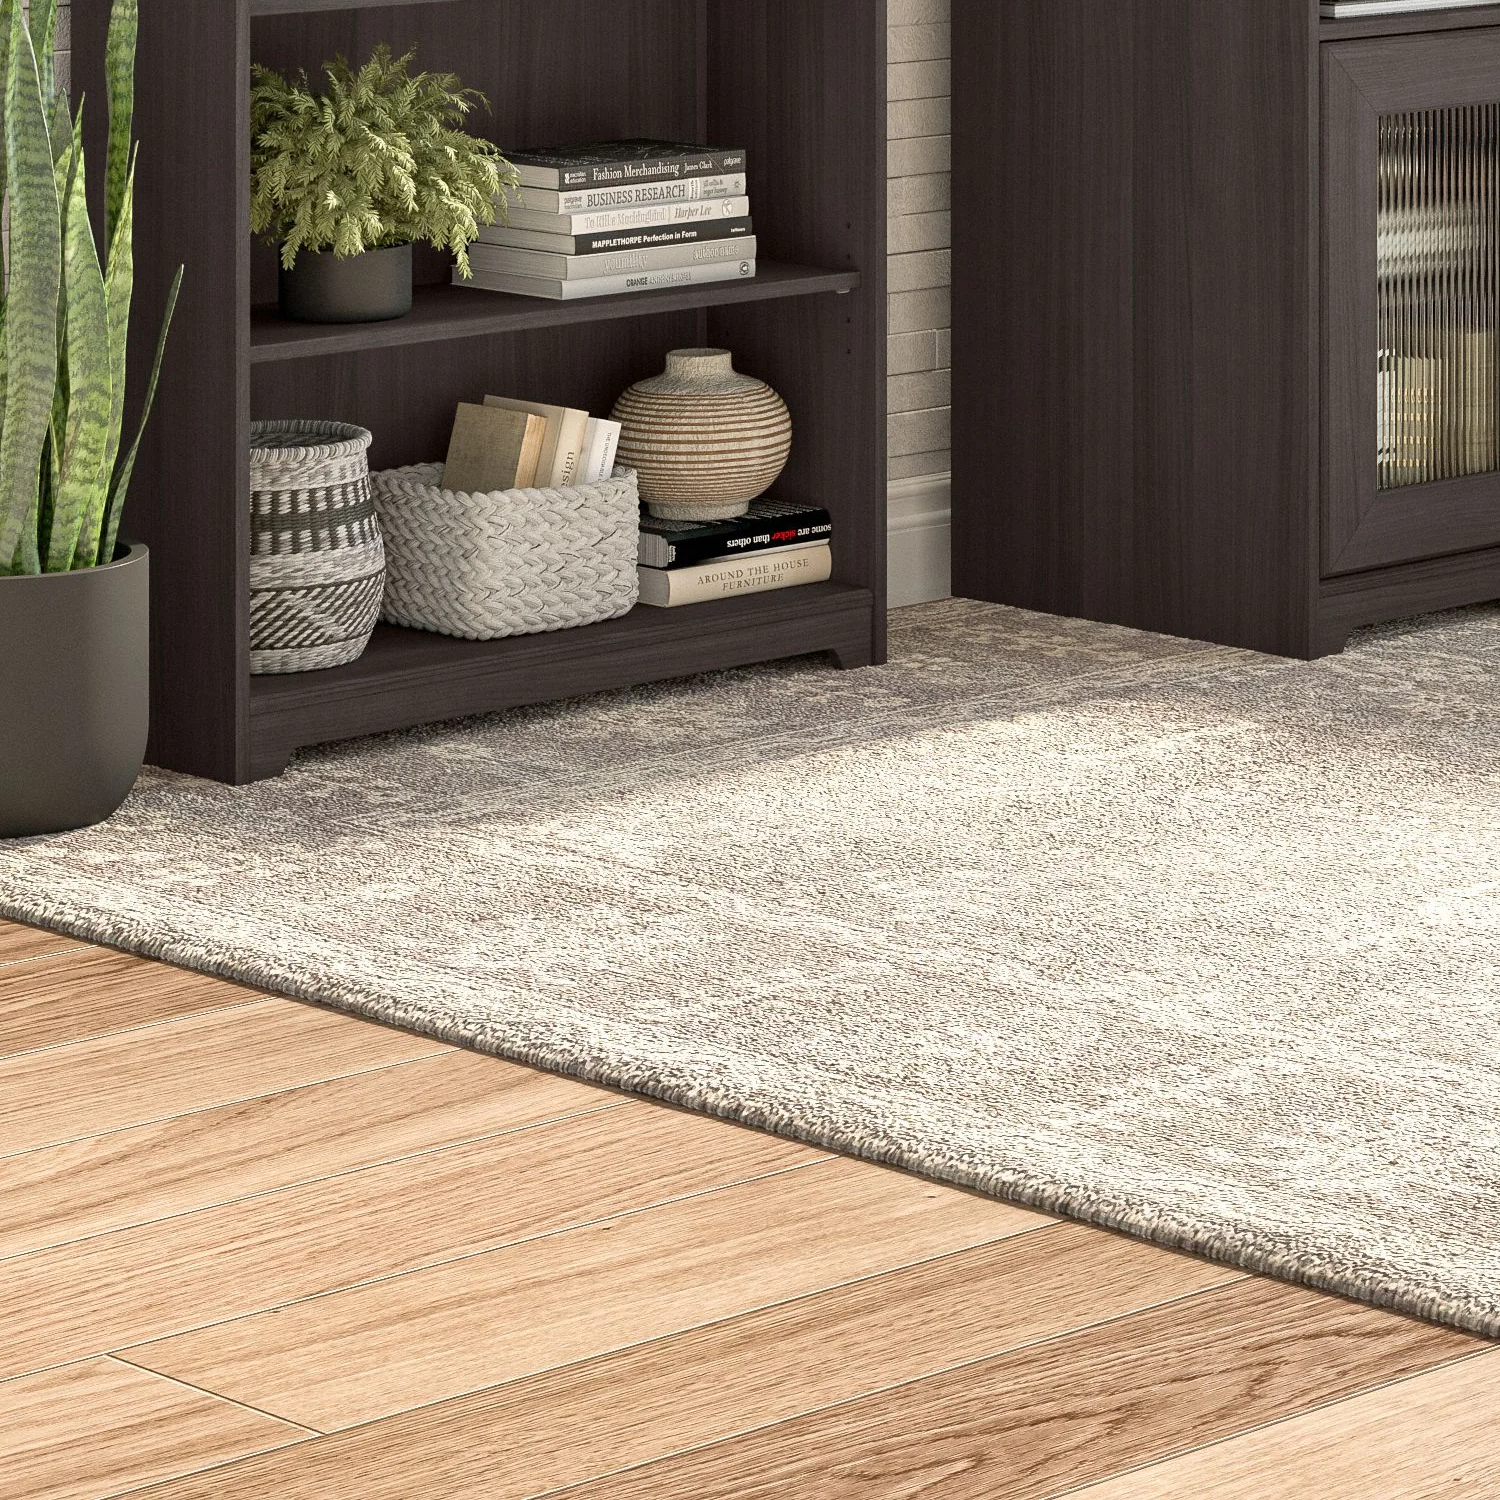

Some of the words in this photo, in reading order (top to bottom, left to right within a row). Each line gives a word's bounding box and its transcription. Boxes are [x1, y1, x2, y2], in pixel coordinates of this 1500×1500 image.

[592, 167, 623, 181] Fashion
[624, 161, 680, 177] Merchandising
[683, 162, 699, 174] James
[699, 160, 713, 169] Clark
[586, 190, 633, 208] BUSINESS
[634, 184, 686, 202] RESEARCH
[584, 217, 595, 229] To
[617, 207, 666, 226] Mockingbird
[674, 207, 699, 220] Harper
[700, 204, 712, 216] Lee
[591, 235, 642, 249] MAPPLETHORPE
[643, 233, 674, 243] Perfection
[681, 231, 697, 239] Form
[626, 276, 648, 287] ORANGE
[771, 529, 797, 541] sicker
[797, 527, 810, 536] are
[811, 523, 832, 534] some
[726, 536, 751, 548] others
[752, 533, 770, 545] than
[697, 569, 744, 585] AROUND
[747, 565, 770, 576] THE
[773, 558, 810, 572] HOUSE
[722, 573, 784, 591] FURNITURE
